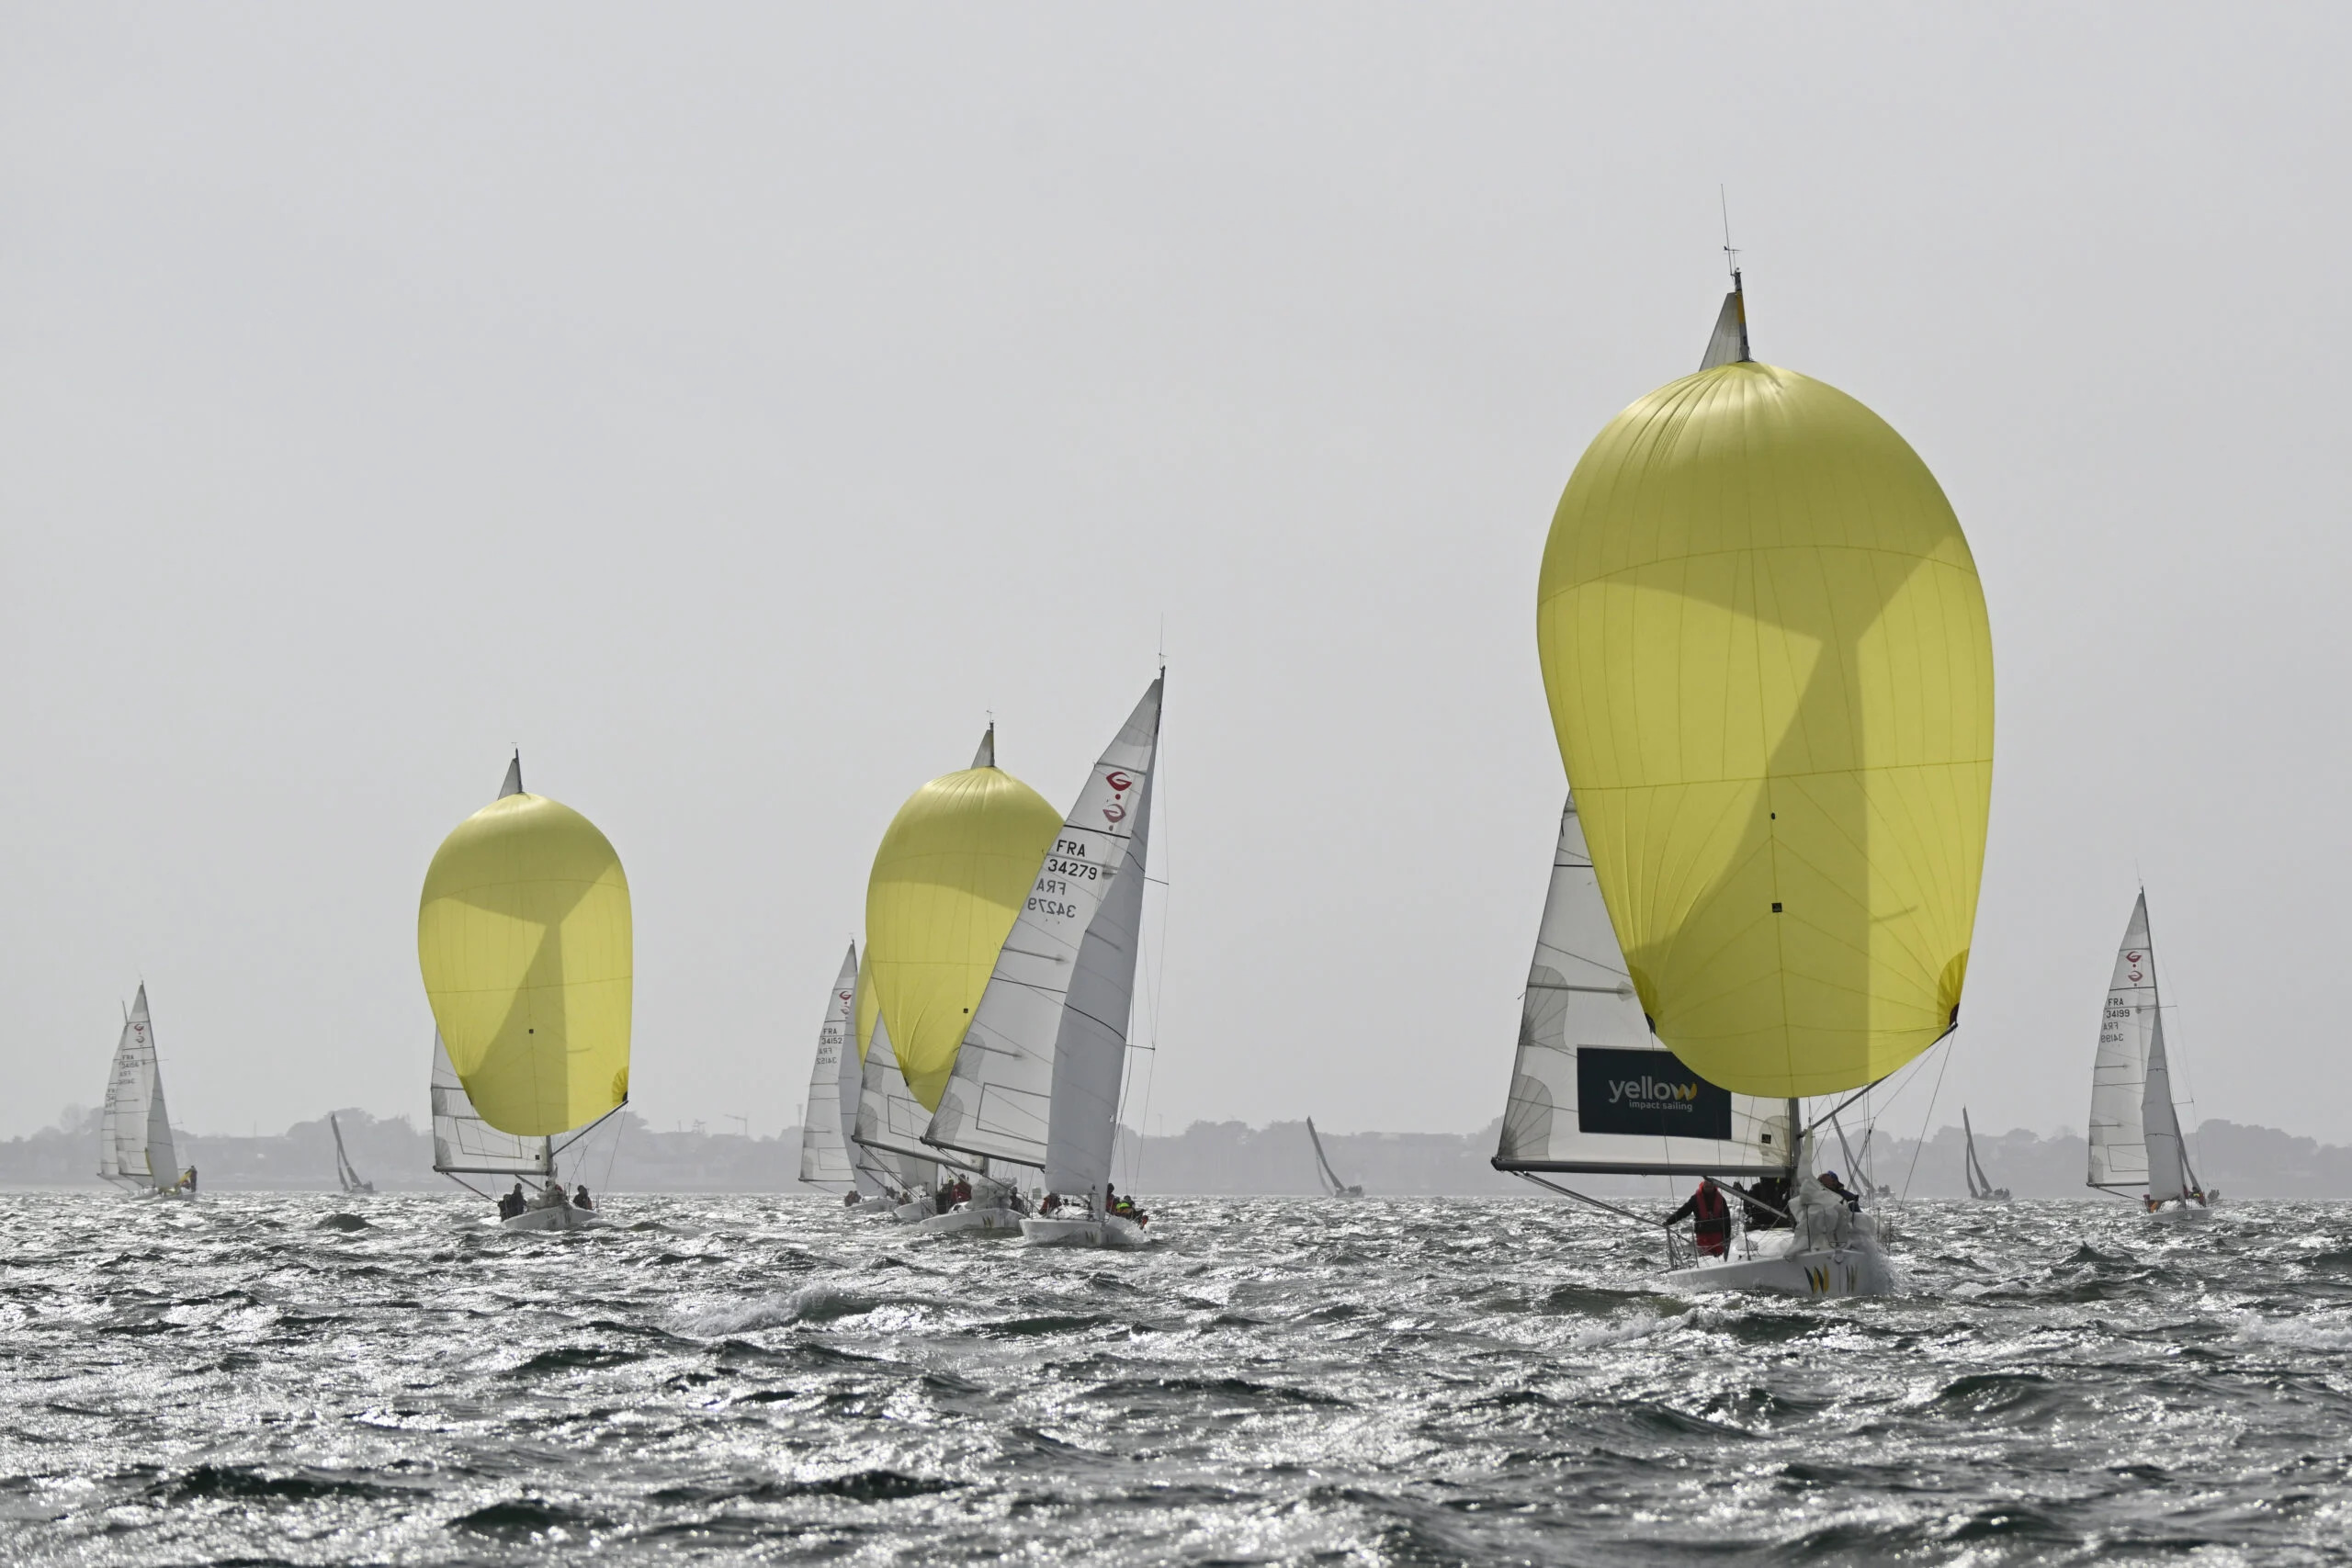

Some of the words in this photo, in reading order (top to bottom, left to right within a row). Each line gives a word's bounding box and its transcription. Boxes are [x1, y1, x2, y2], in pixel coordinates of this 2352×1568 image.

[1057, 840, 1085, 858] FRA
[1047, 859, 1098, 880] 34279
[2108, 998, 2124, 1006] FRA
[2106, 1009, 2131, 1019] 34199
[1608, 1076, 1698, 1103] yellow
[1629, 1100, 1660, 1110] impact
[1662, 1101, 1692, 1112] sailing
